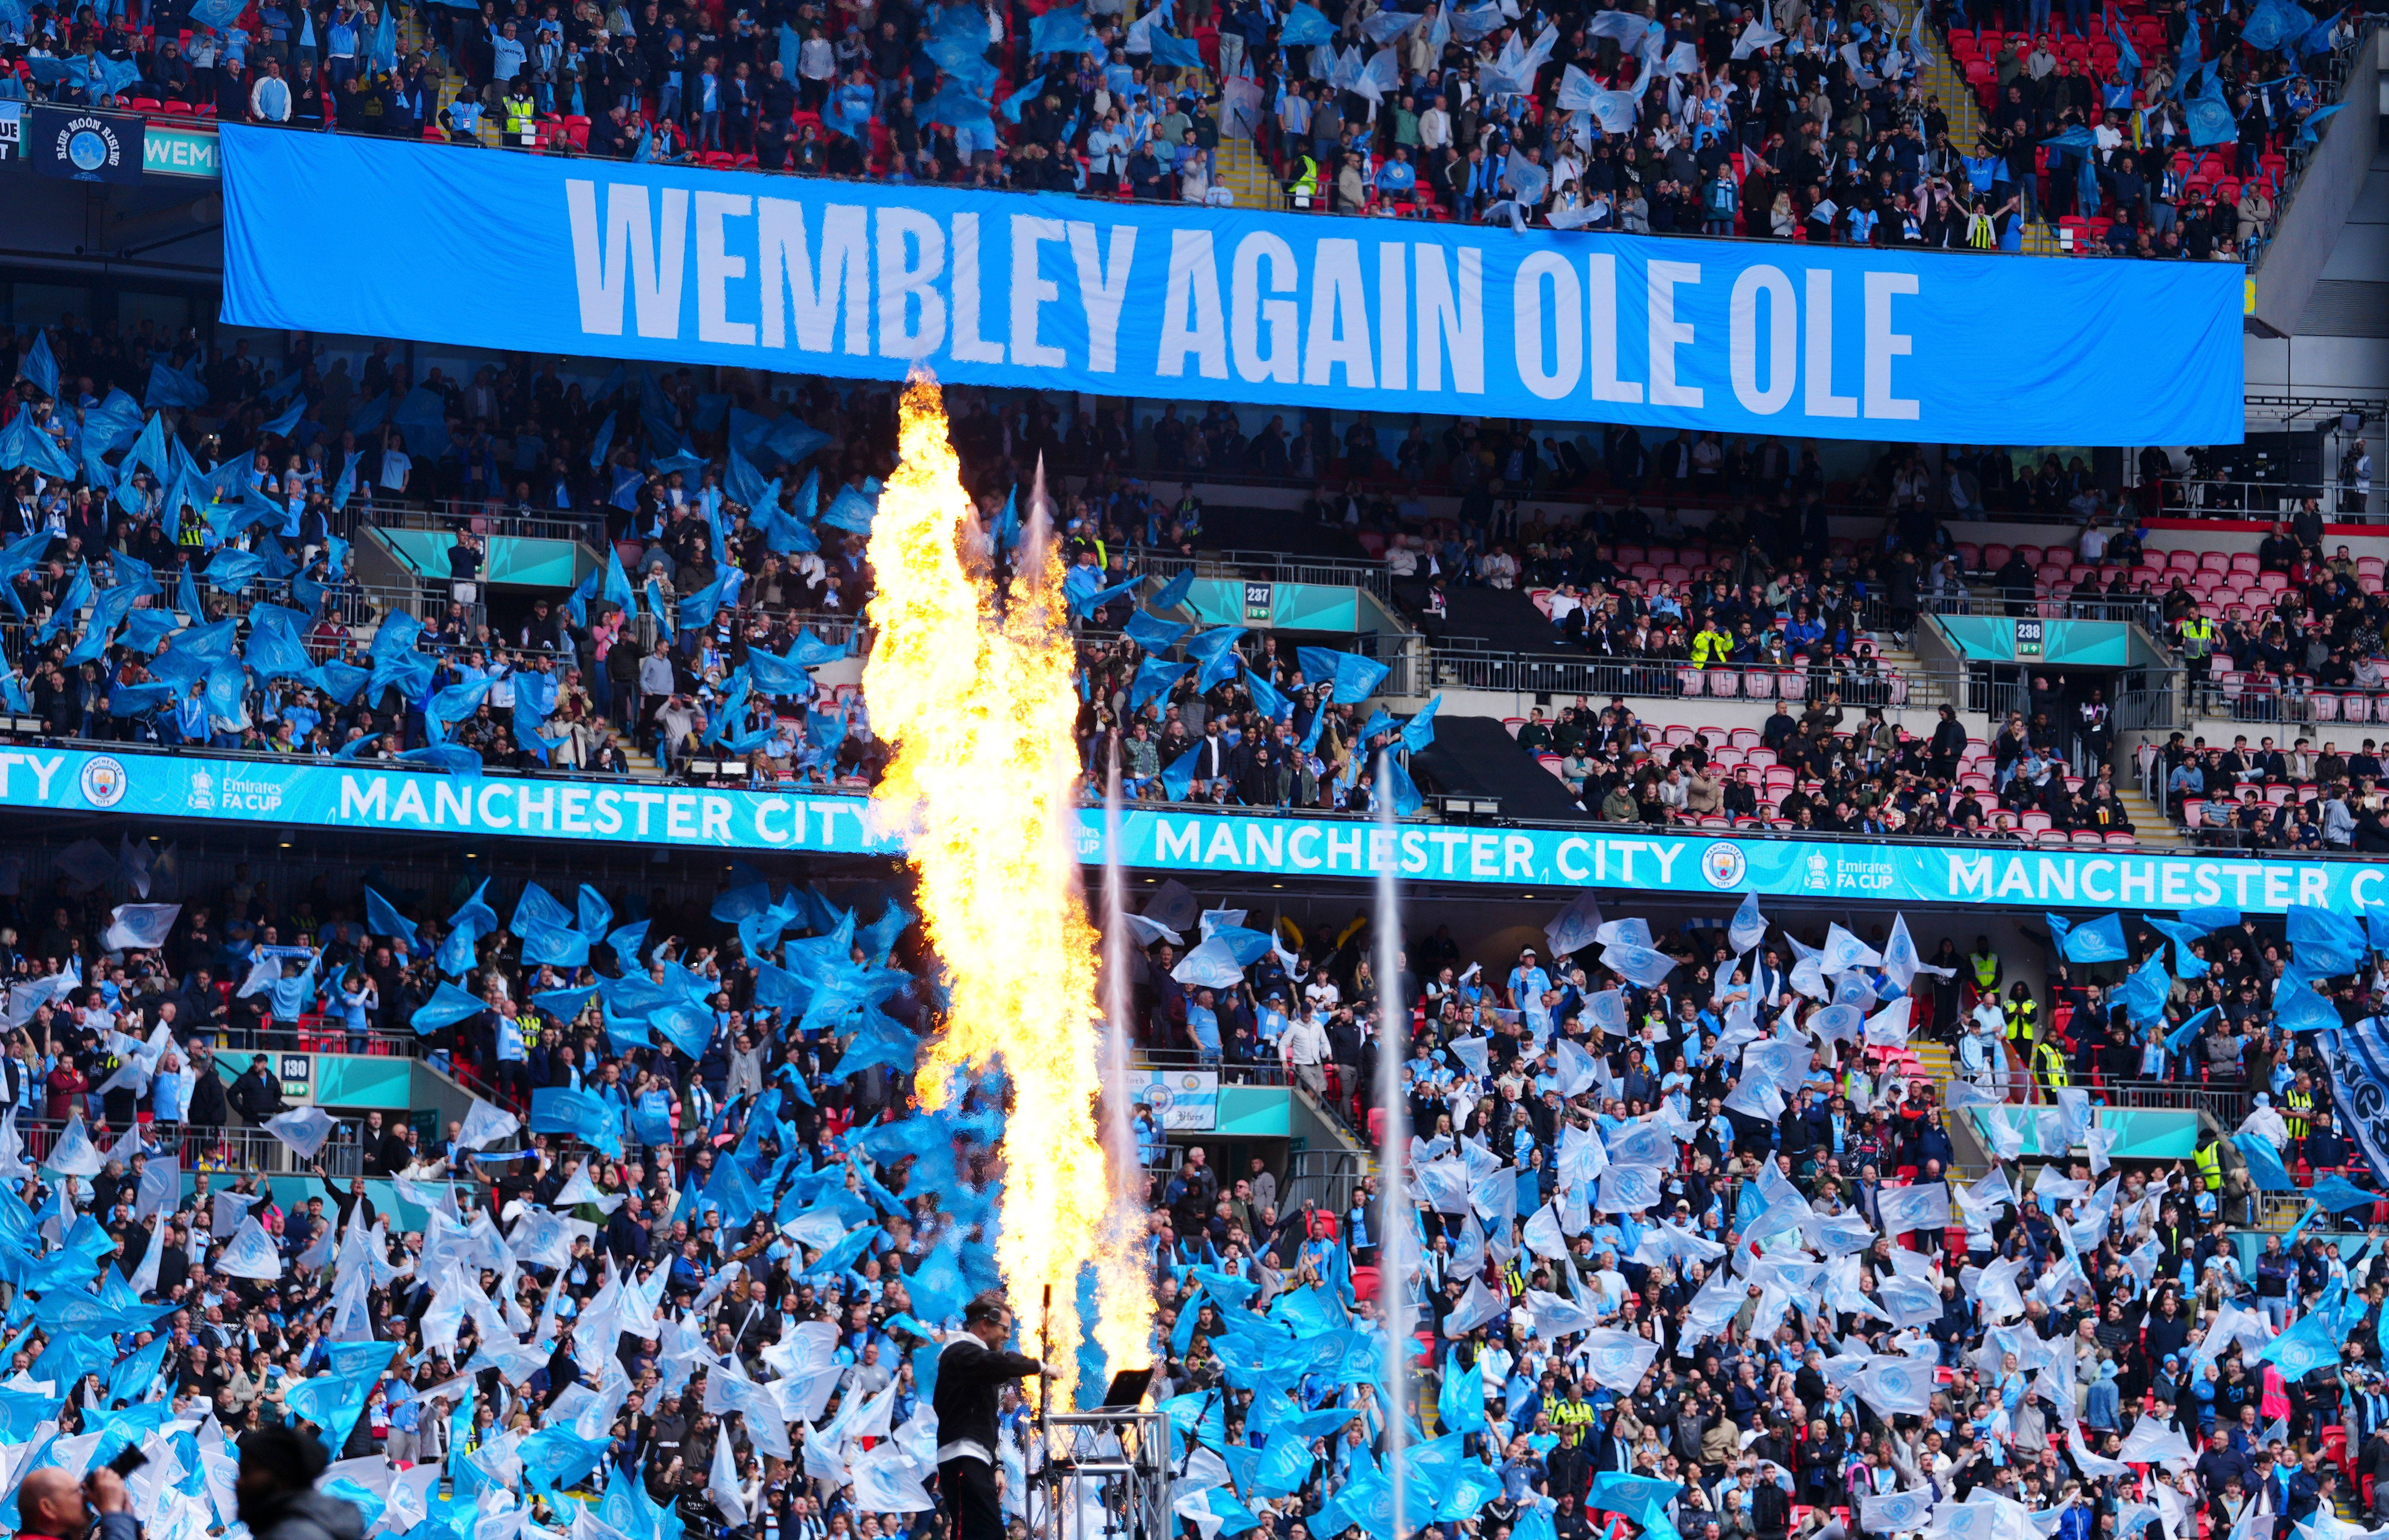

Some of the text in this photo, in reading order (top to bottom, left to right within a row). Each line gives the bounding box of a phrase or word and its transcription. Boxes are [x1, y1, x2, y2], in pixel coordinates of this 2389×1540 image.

[56, 117, 120, 167] BLUE MOON RISING
[566, 180, 1919, 419] WEMBLEY AGAIN OLE OLE
[1247, 587, 1269, 603] 237
[2017, 623, 2041, 639] 238
[85, 759, 123, 776] MANCHESTER
[223, 778, 281, 796] Emirates
[222, 794, 282, 811] FA CUP
[341, 776, 877, 847] MANCHESTER CITY
[1156, 819, 1685, 883] MANCHESTER CITY
[1706, 844, 1742, 860] MANCHESTER
[1837, 860, 1892, 874] Emirates
[1837, 874, 1893, 889] FA CUP
[1949, 855, 2329, 909] MANCHESTER
[284, 1059, 307, 1077] 130
